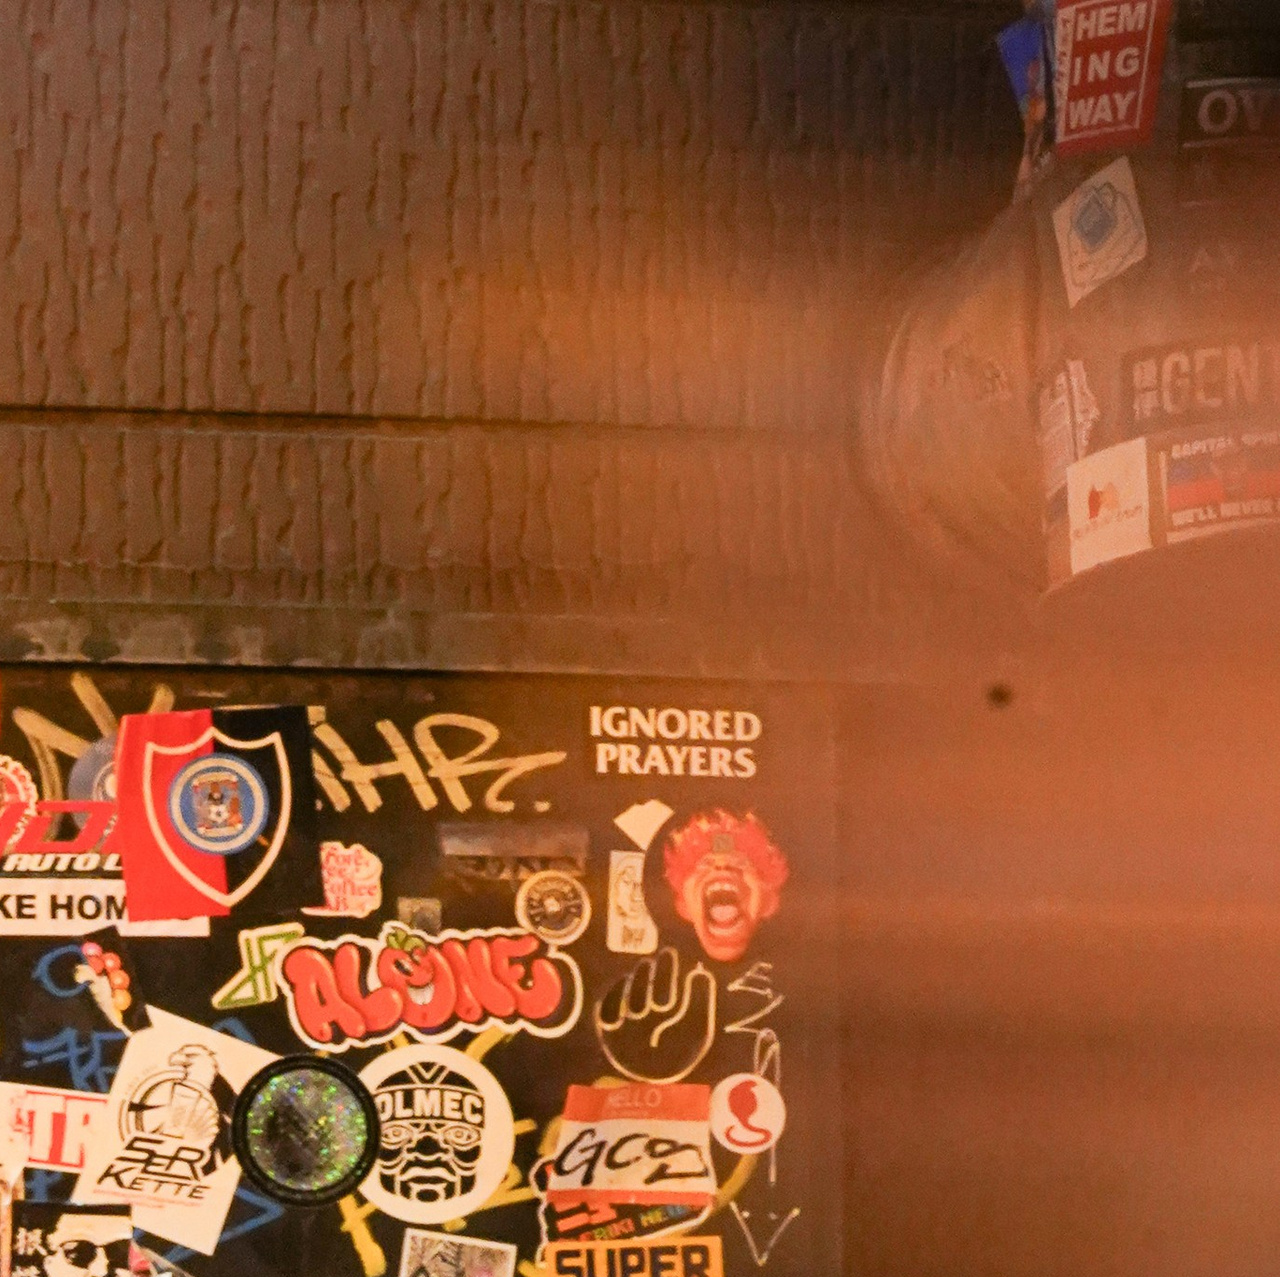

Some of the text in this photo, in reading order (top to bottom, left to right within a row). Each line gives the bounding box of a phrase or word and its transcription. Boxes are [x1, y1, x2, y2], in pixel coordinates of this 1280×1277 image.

[1076, 2, 1148, 42] HEM
[1071, 46, 1140, 87] ING
[1068, 90, 1137, 131] WAY
[590, 706, 761, 742] IGNORED
[596, 743, 757, 778] PRAYERS
[3, 853, 101, 871] AUTO
[283, 932, 562, 1042] ALONE
[374, 1088, 486, 1125] OLMEC
[97, 1163, 211, 1200] KETTE
